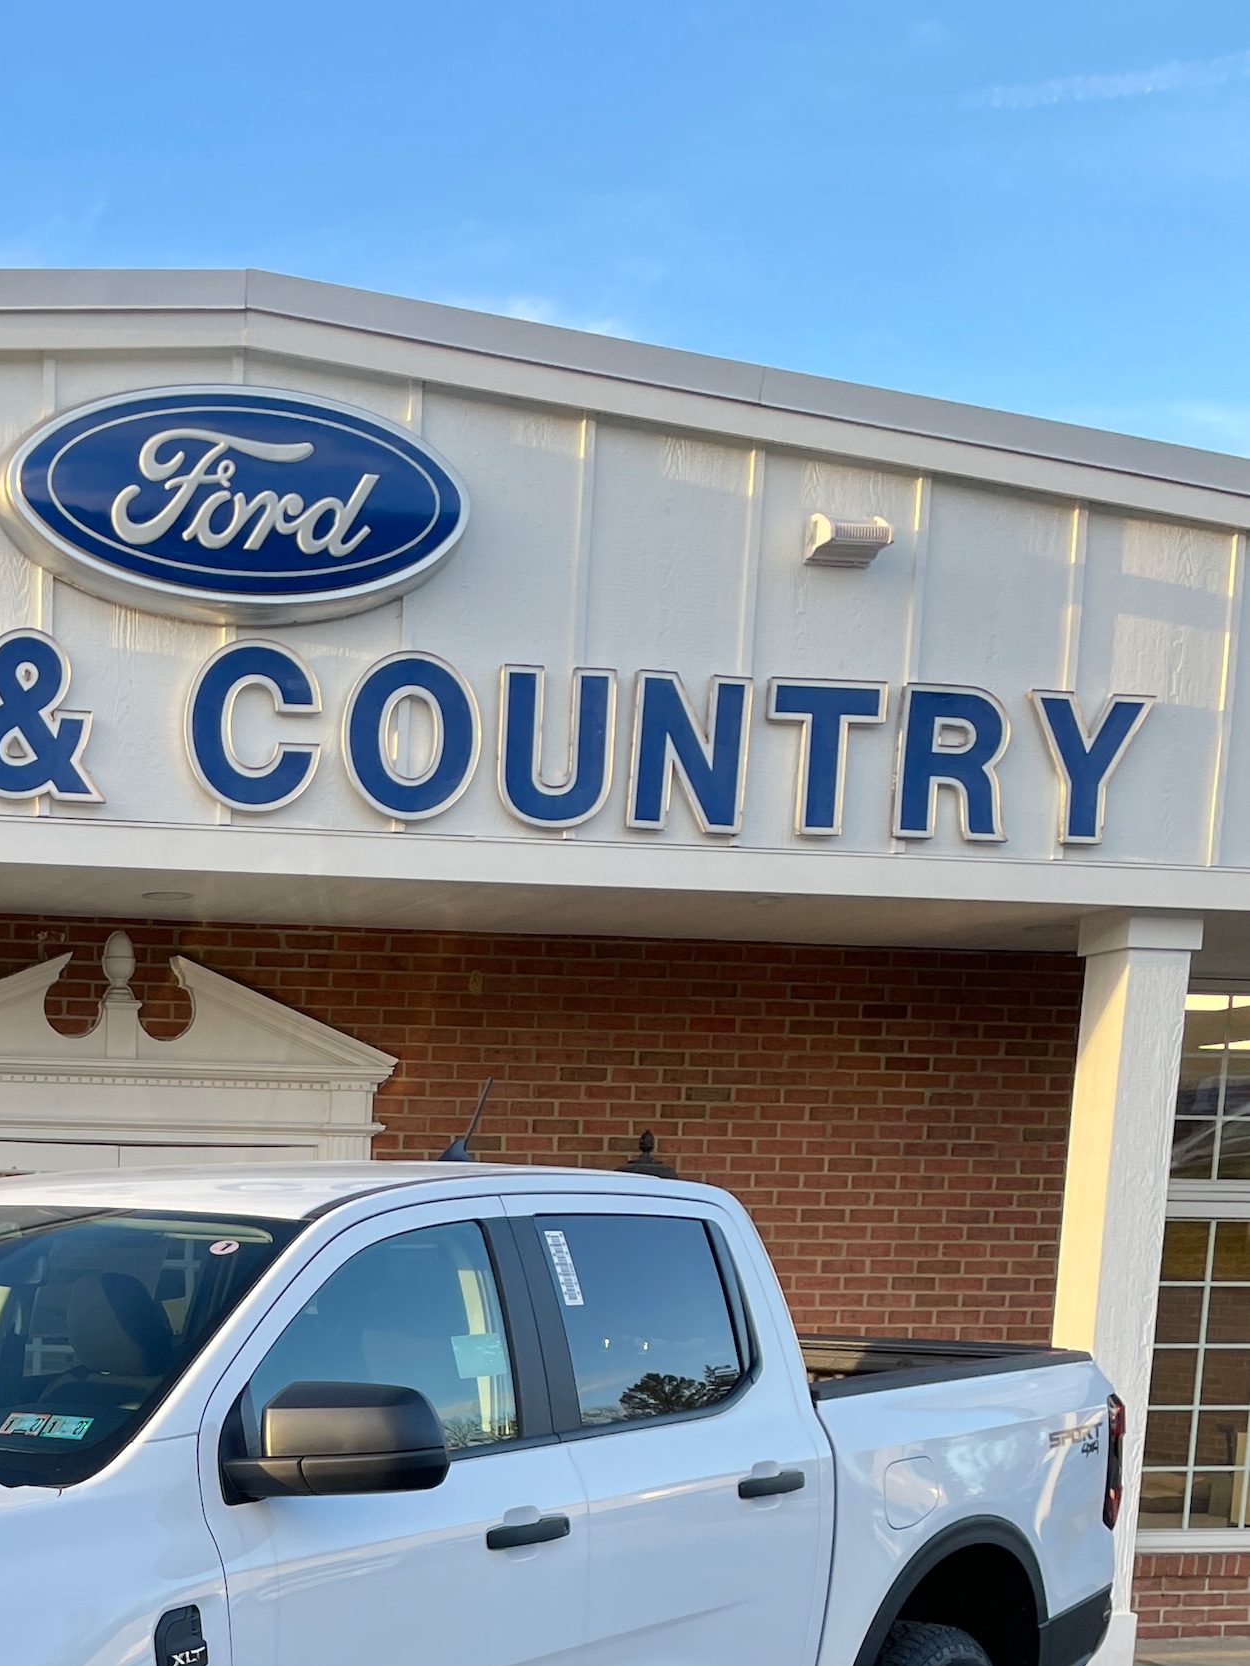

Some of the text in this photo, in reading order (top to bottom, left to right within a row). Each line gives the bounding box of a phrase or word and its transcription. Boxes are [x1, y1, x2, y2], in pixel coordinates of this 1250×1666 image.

[110, 427, 381, 559] Ford
[184, 638, 1158, 845] COUNTRY
[1048, 1421, 1104, 1449] SPORT
